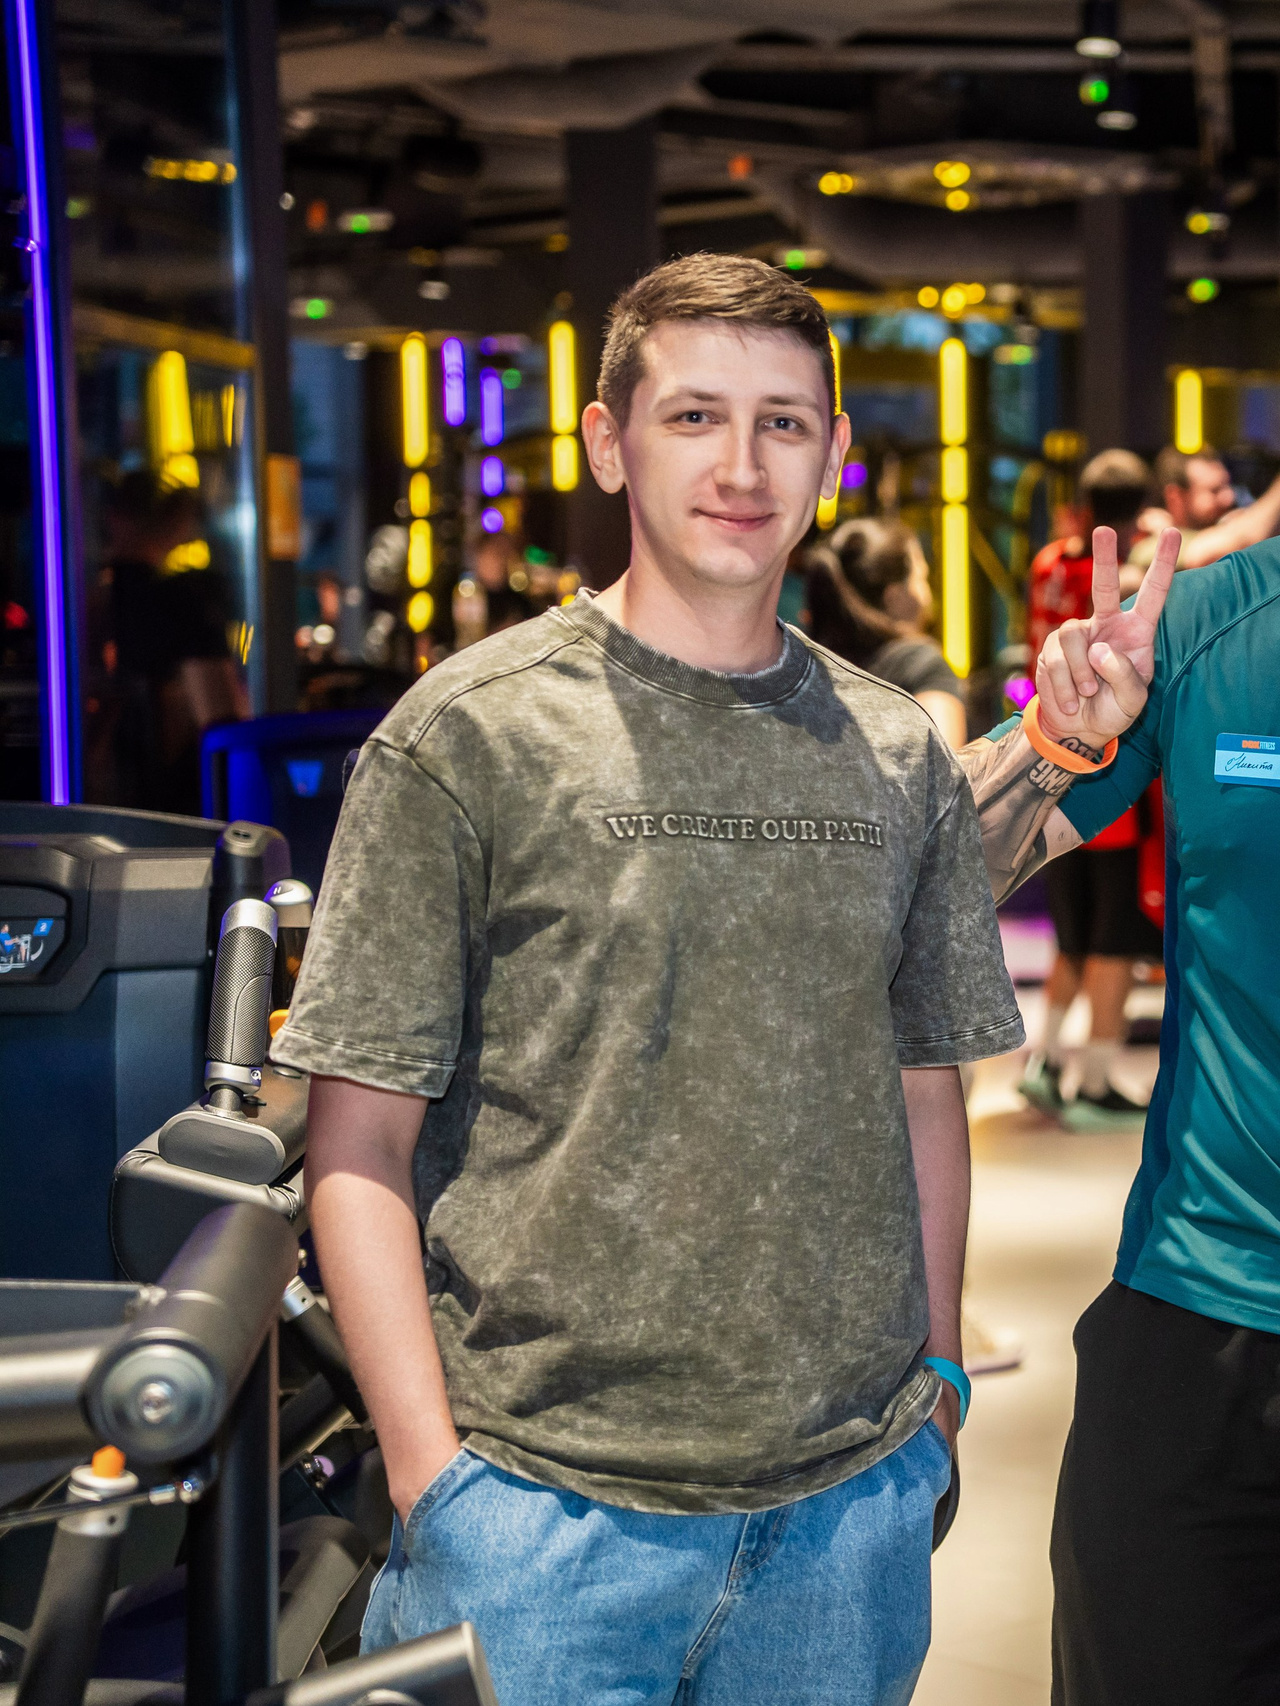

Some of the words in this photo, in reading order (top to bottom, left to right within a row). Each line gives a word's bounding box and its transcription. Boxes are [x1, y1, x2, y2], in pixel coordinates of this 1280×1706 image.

[606, 814, 657, 839] WE
[661, 813, 756, 840] CREATE
[761, 819, 819, 841] OUR
[823, 820, 883, 846] PATH
